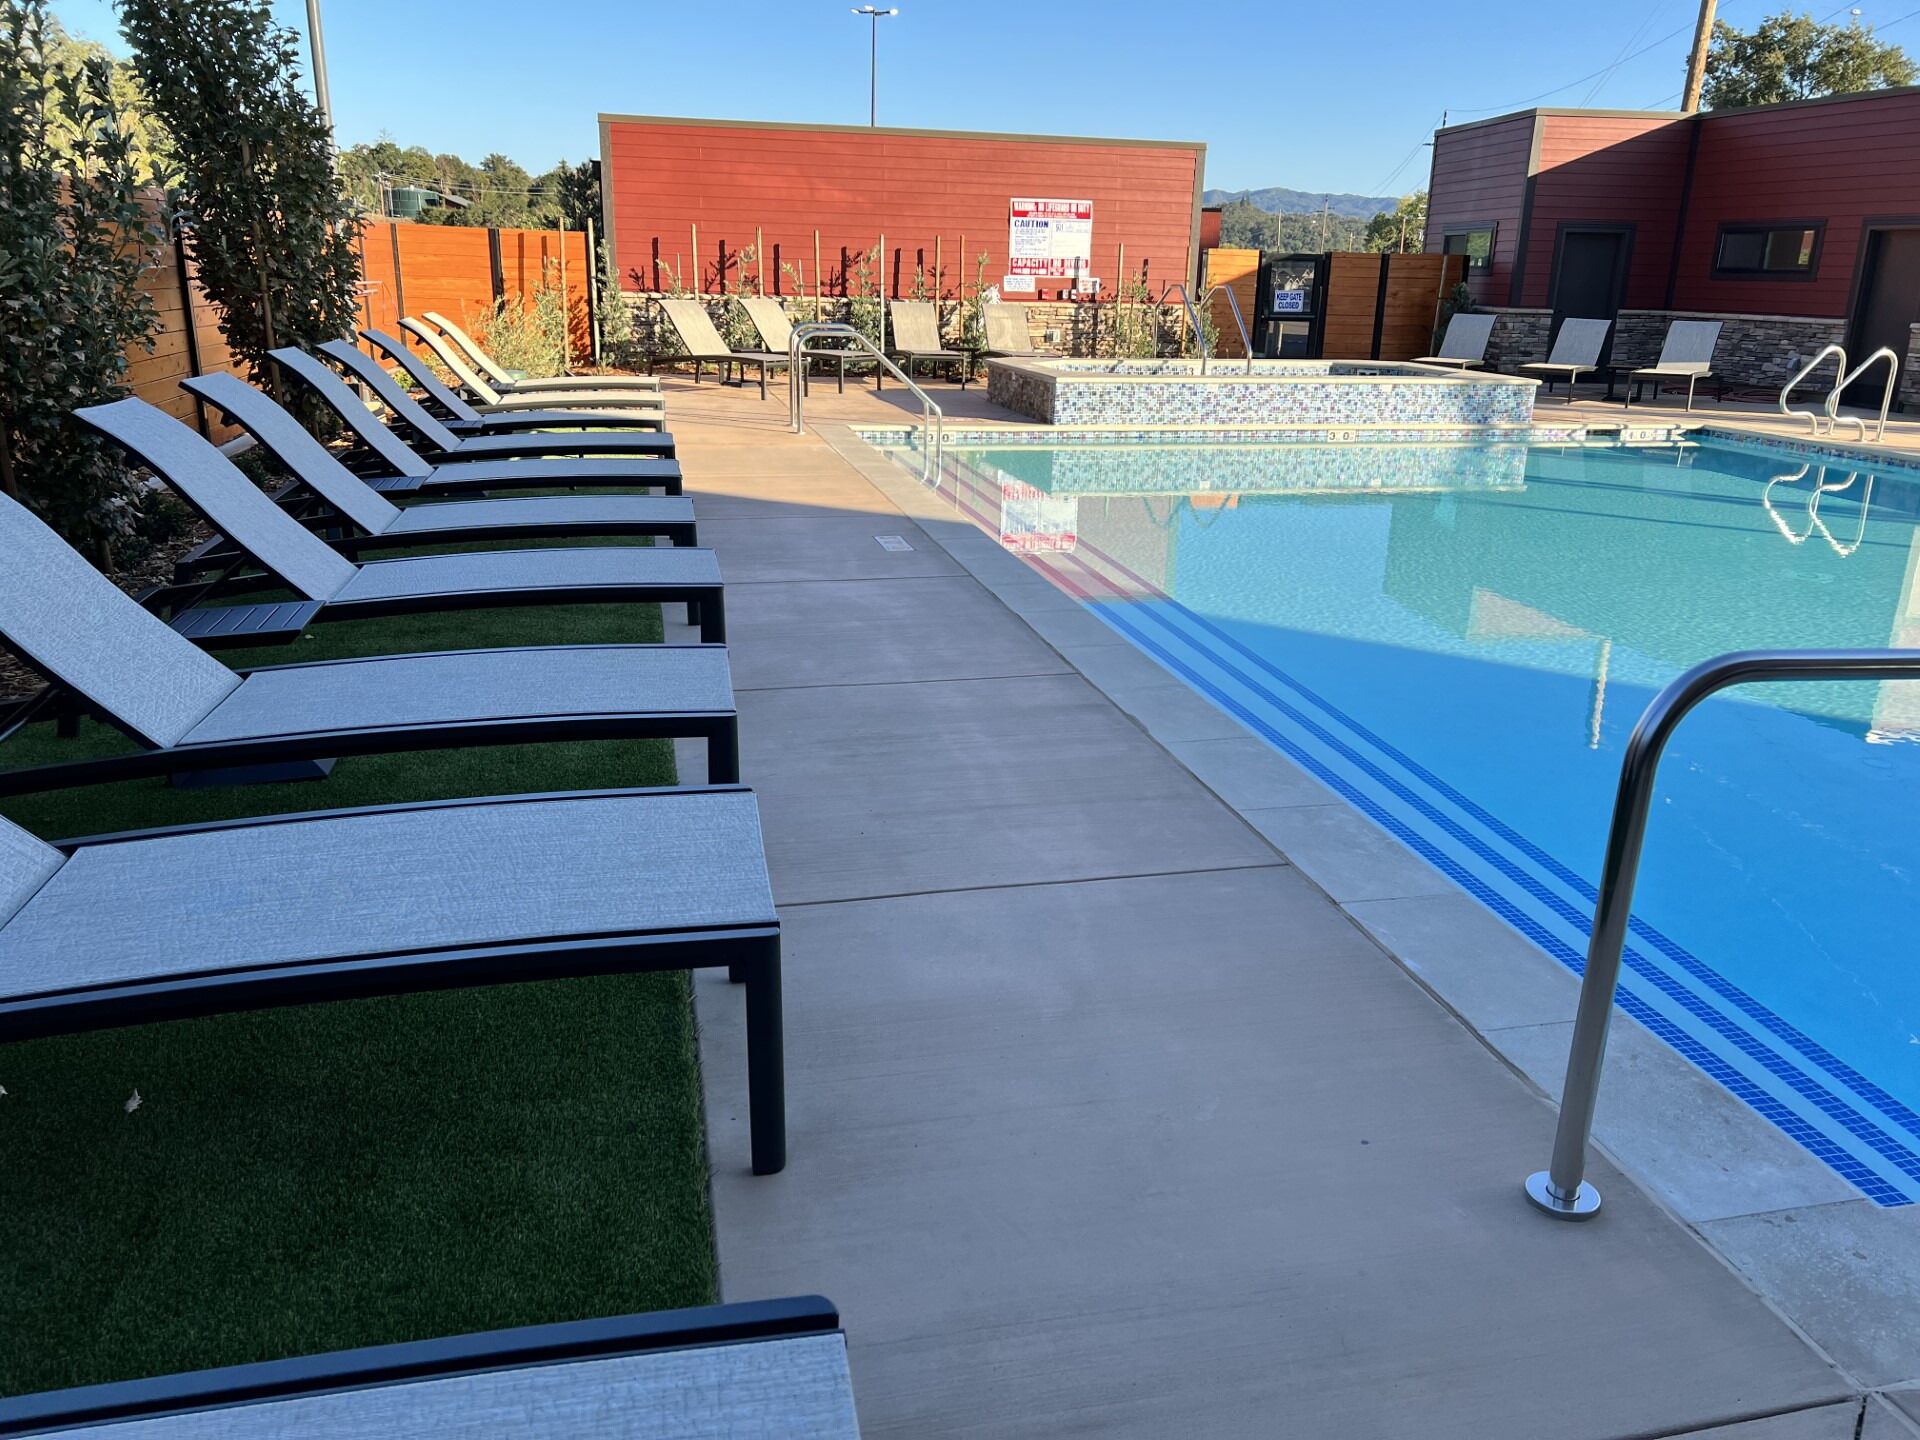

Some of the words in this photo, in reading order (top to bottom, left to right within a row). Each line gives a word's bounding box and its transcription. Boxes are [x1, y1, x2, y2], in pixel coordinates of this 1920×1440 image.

[1014, 220, 1049, 228] CAUTION
[1012, 258, 1048, 267] CAPACITY
[1277, 292, 1289, 300] KEEP
[1290, 293, 1302, 301] GATE
